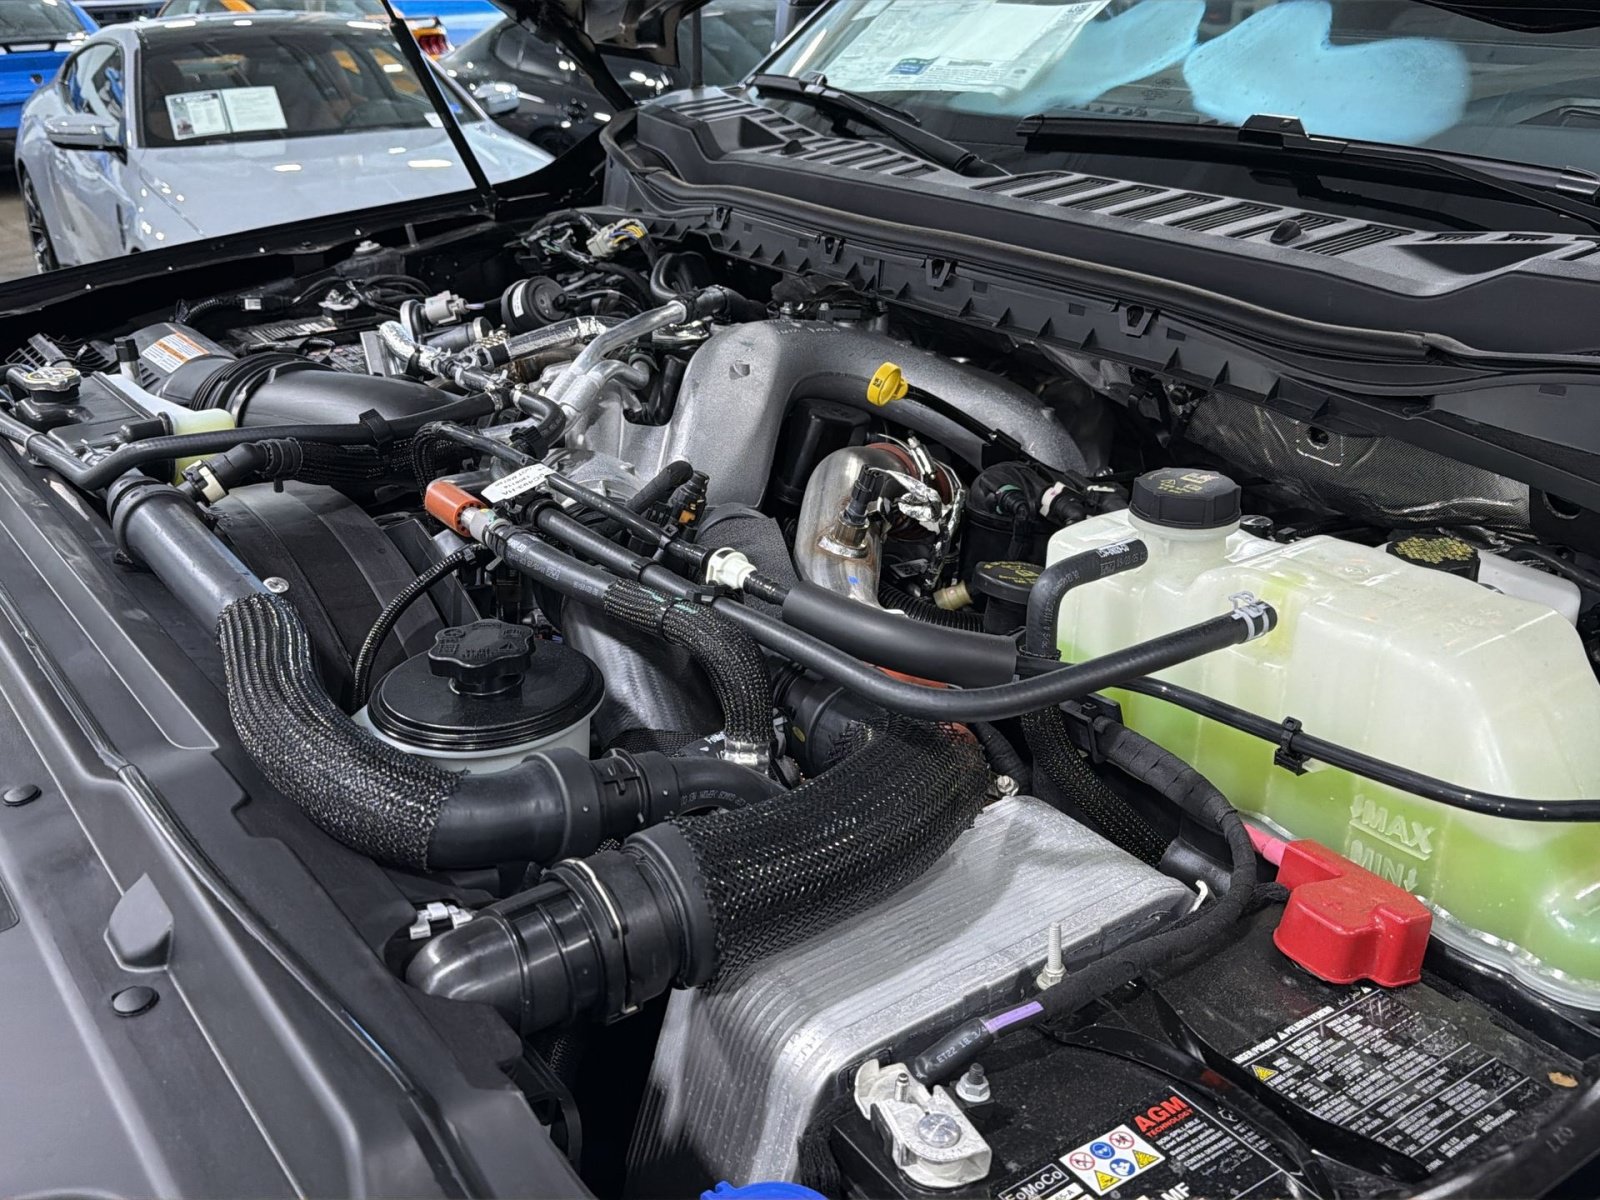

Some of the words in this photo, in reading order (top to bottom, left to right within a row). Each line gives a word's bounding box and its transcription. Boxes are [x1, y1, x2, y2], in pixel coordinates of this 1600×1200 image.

[1362, 799, 1435, 854] MAX
[1349, 839, 1405, 888] MIN
[1134, 1096, 1188, 1132] AGM
[1146, 1108, 1194, 1137] TECHNOLOGY
